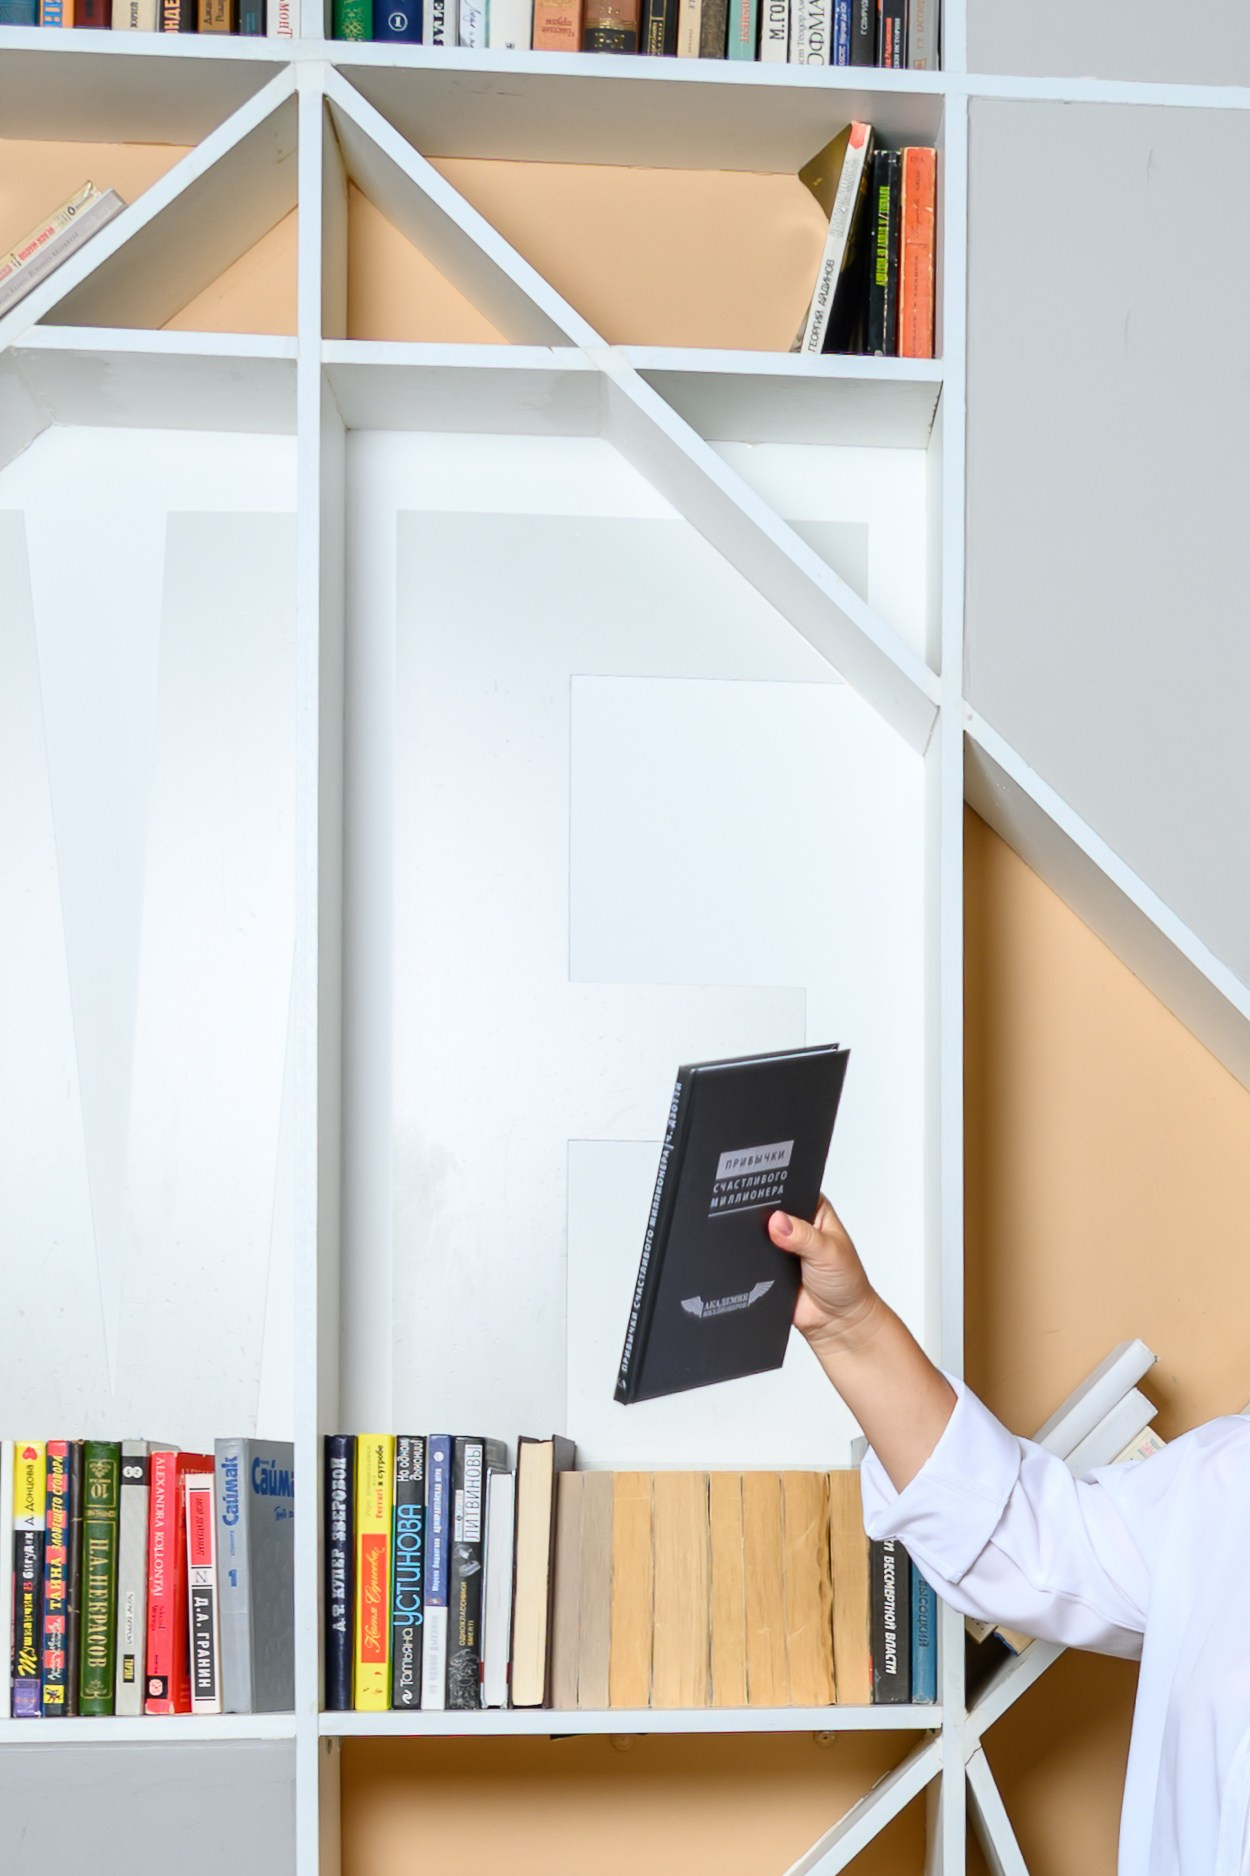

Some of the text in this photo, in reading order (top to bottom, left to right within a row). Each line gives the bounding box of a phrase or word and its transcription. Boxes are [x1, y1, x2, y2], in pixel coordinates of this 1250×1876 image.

[713, 1170, 788, 1194] СЧАСТЛИВОГО
[725, 1150, 786, 1170] ПРИВЫЧКИ
[710, 1185, 784, 1208] МИЛЛИОНЕРА
[621, 1311, 638, 1373] ПРИВЫЧКИ
[633, 1229, 655, 1311] СЧАСТЛИВОГО
[648, 1150, 671, 1228] МИЛЛИОНЕРА
[24, 1464, 35, 1512] Донцова
[220, 1455, 240, 1527] Саймак
[464, 1445, 482, 1541] ЛИТВИНОВЫ
[151, 1456, 166, 1597] ALEXANDRA KOLLONTAI
[49, 1556, 63, 1611] ТАЙНА
[393, 1504, 424, 1688] Татьяна УСТИНОВА
[883, 1555, 898, 1630] БЕССМЕРТНОЙ
[918, 1578, 931, 1648] ВЫСОЦКИЙ
[194, 1596, 212, 1689] Д.А. ГРАНИН
[884, 1632, 898, 1675] ВЛАСТИ
